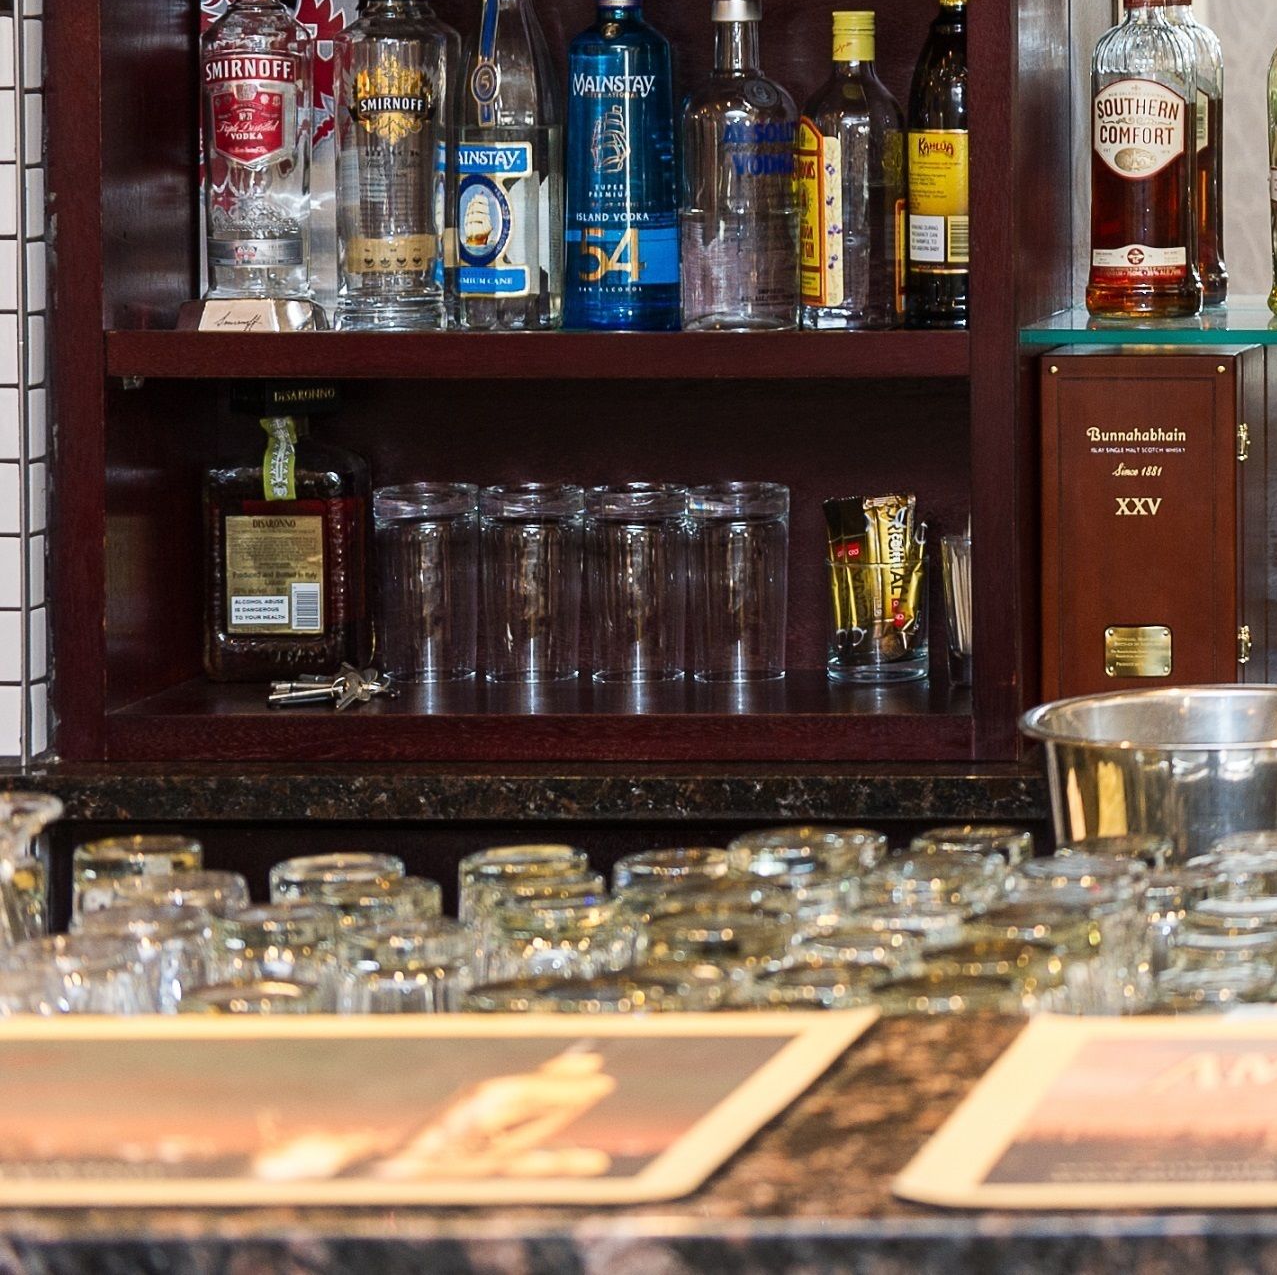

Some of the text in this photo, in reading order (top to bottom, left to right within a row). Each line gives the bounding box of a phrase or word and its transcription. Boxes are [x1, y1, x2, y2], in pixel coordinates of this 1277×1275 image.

[205, 59, 291, 81] SMIRNOFF
[573, 73, 656, 98] MAINSTAY
[361, 97, 423, 112] SMIRNOFF
[1097, 98, 1180, 120] SOUTHERN
[1099, 125, 1175, 145] COMFORT
[459, 150, 519, 170] AINSTAY
[588, 190, 631, 198] PREMIUM
[576, 212, 650, 221] ISLAND VODKA
[579, 227, 646, 282] 54
[487, 276, 513, 285] CANE
[274, 387, 336, 403] DISARONNO
[1087, 426, 1187, 442] Bunnahabhain
[1112, 462, 1163, 477] Since 1881
[1115, 497, 1162, 516] XXV
[252, 518, 297, 529] DISARONNO
